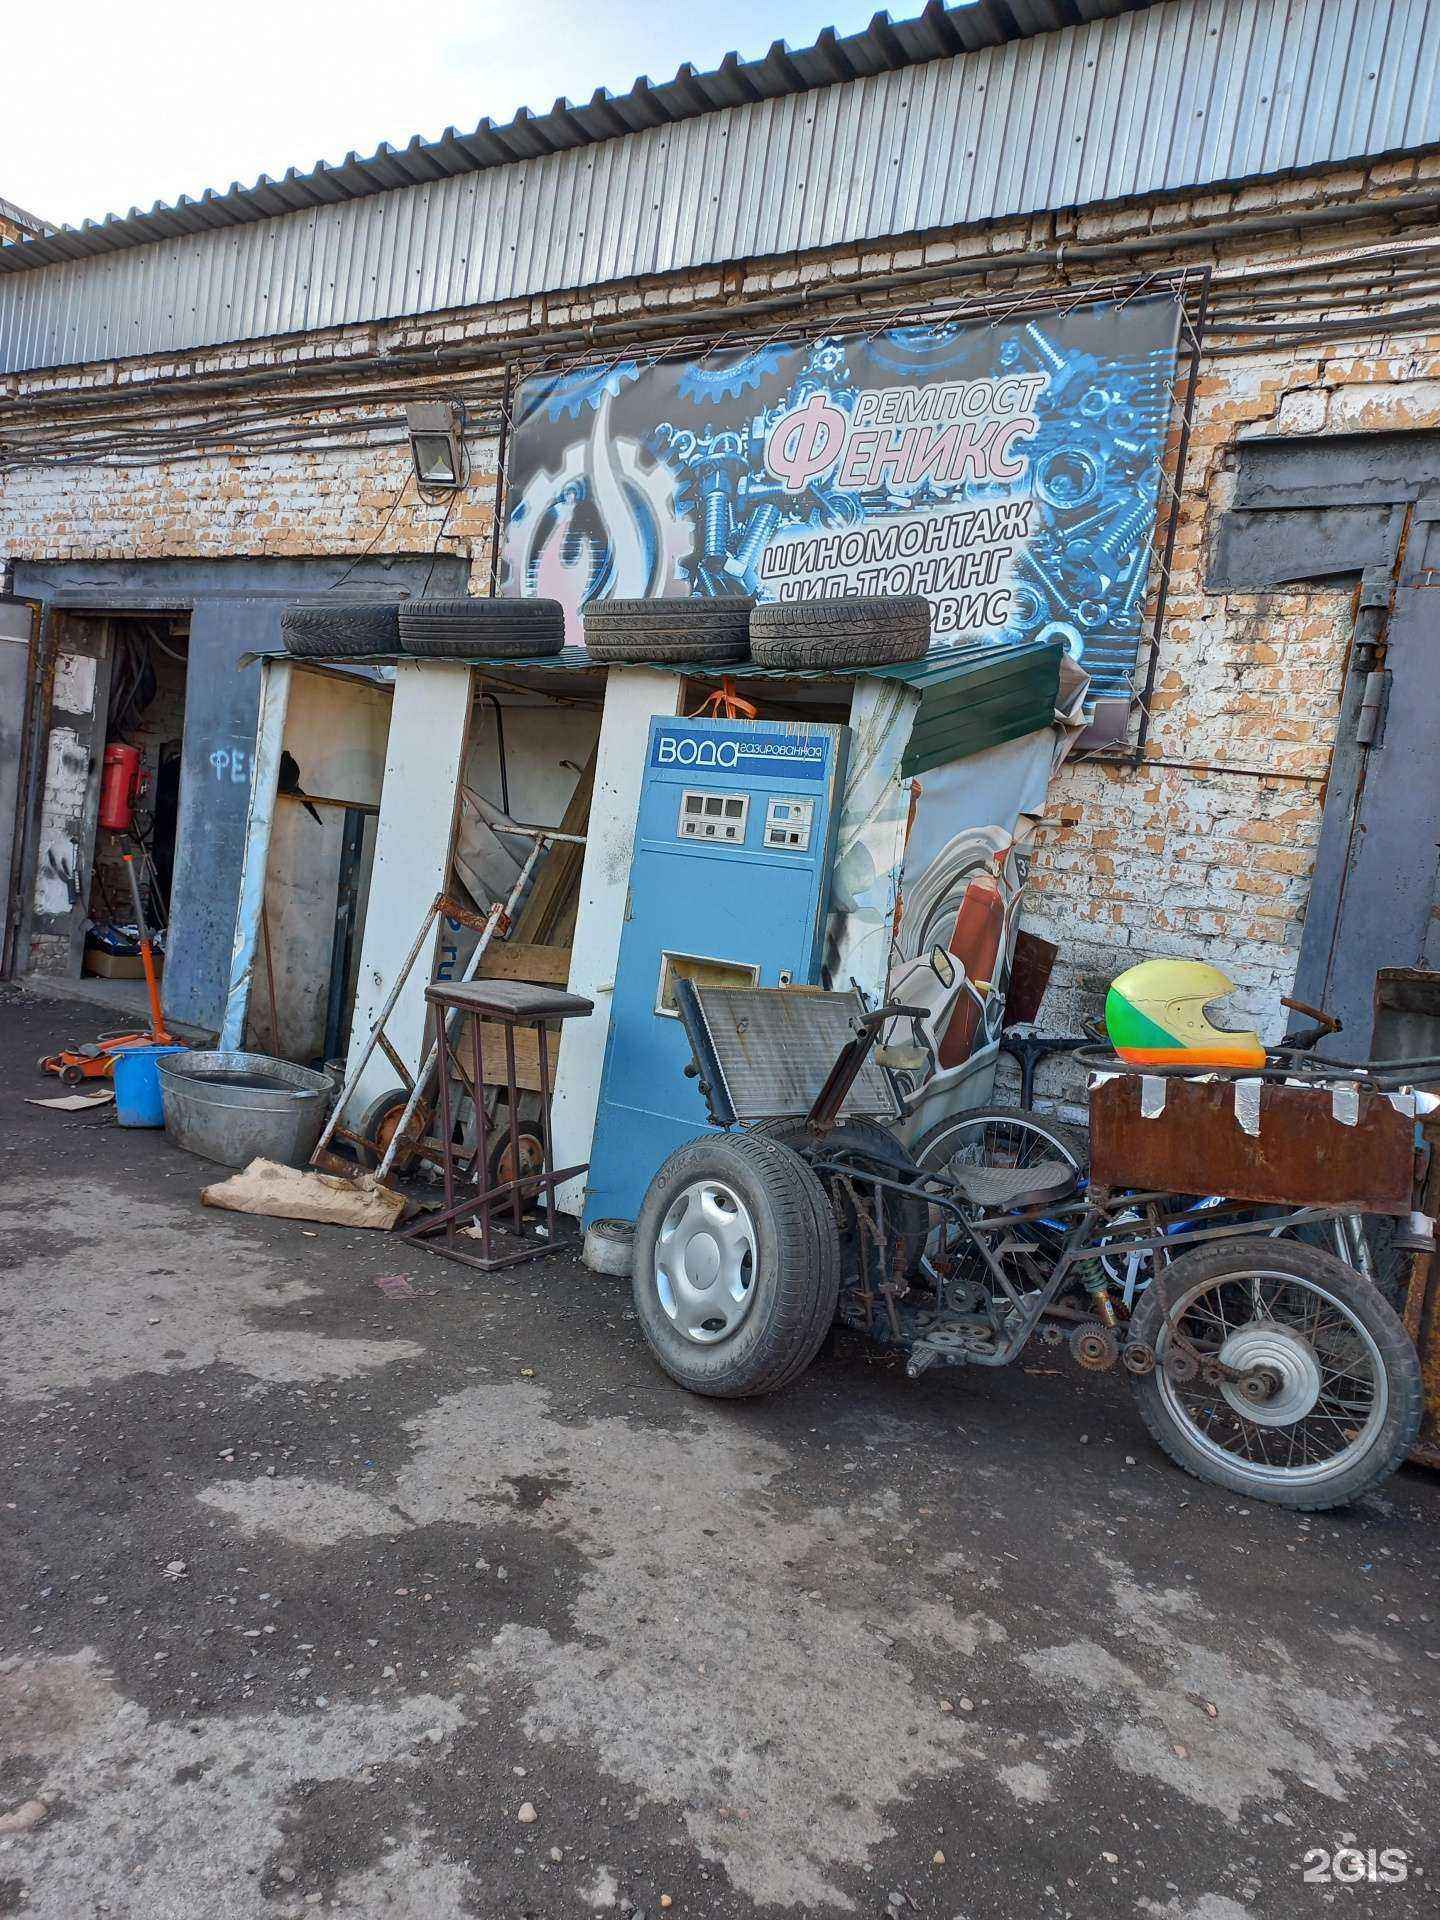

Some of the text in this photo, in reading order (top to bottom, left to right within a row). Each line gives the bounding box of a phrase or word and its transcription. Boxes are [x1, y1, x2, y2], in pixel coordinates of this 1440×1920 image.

[853, 377, 1046, 427] РЕМПОСТ
[760, 501, 1034, 579] ШИНОМОНТАЖ
[209, 748, 257, 783] ФЕ
